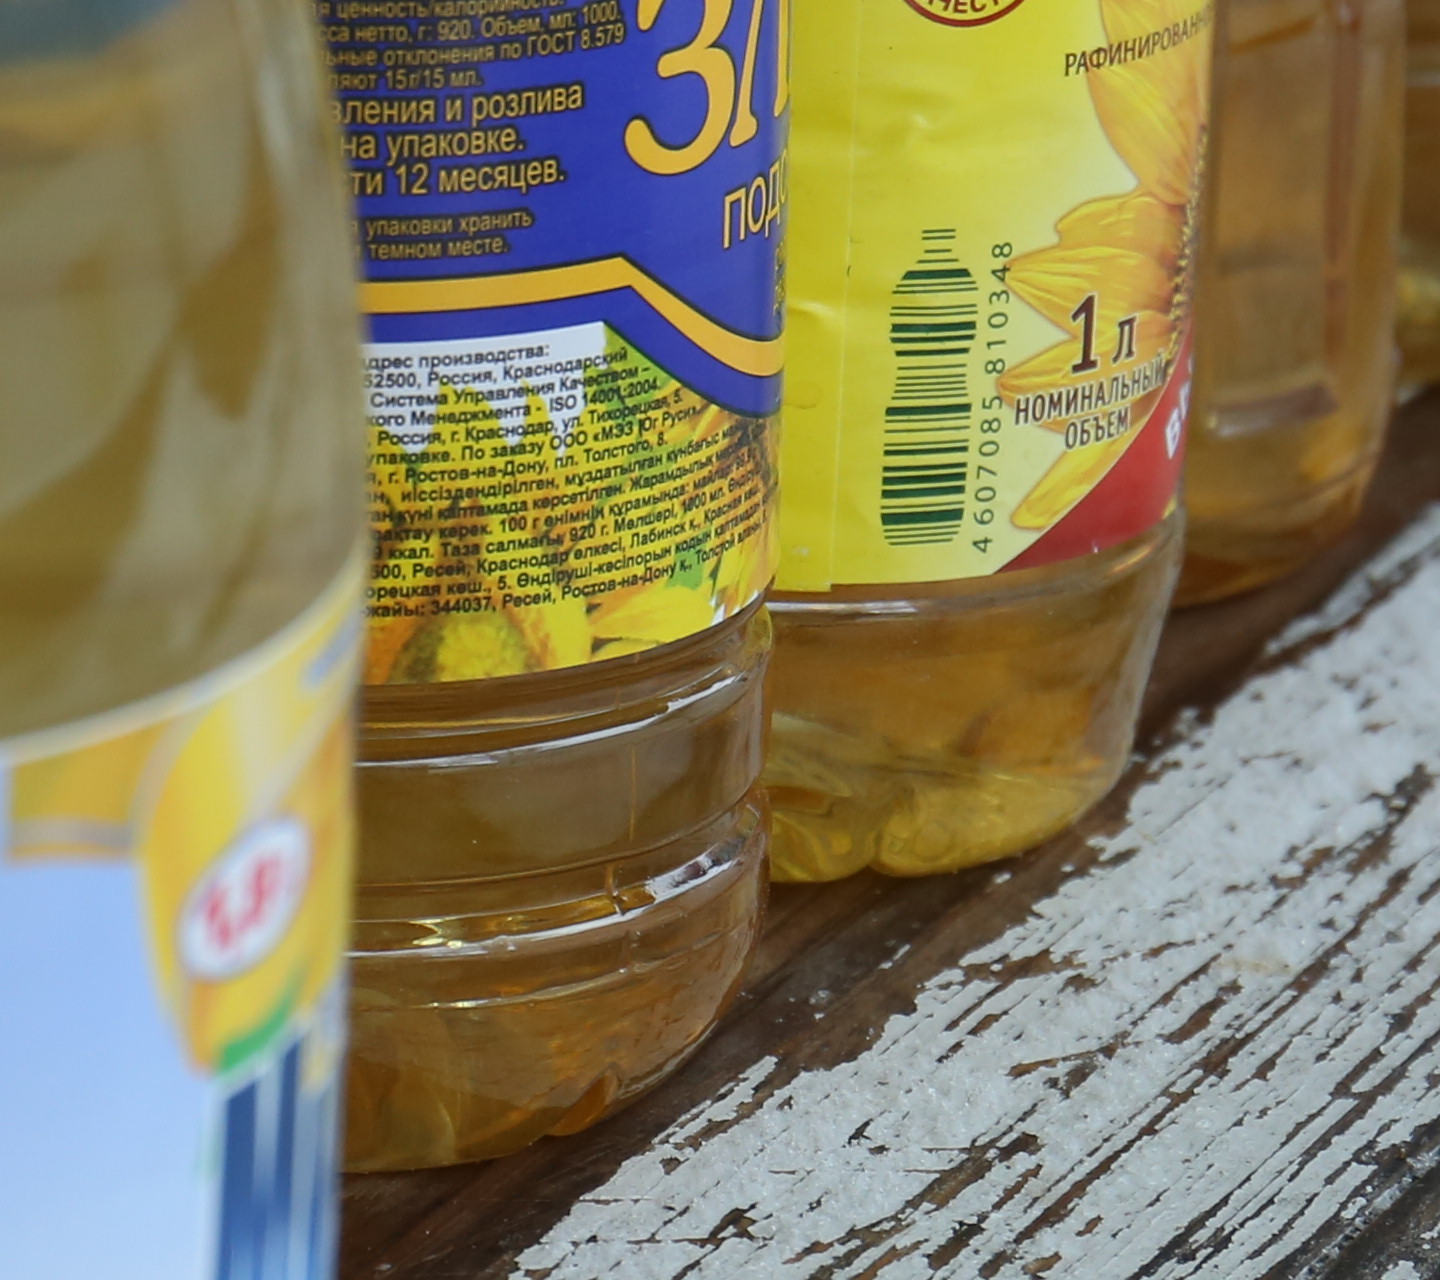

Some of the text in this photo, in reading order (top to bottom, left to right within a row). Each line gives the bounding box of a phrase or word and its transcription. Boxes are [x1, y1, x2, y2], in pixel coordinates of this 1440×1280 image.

[383, 45, 495, 66] отклонения
[500, 42, 522, 59] по
[527, 31, 576, 56] ГОСТ
[580, 23, 625, 50] 8.579
[444, 98, 462, 122] и
[472, 83, 583, 128] розлива
[386, 127, 524, 167] упаковке.
[395, 162, 429, 195] 12
[438, 158, 566, 195] месяцев.
[366, 216, 453, 241] упаковки
[459, 210, 534, 237] хранить
[368, 236, 510, 261] темном месте.
[1070, 293, 1139, 375] 1 л
[418, 344, 550, 372] производства:
[427, 370, 498, 387] Россия,
[503, 347, 629, 380] Краснодарский
[371, 365, 640, 408] Система Управления Качеством
[1014, 348, 1167, 428] НОМИНАЛЬНЫЙ
[377, 430, 447, 446] Россия,
[465, 419, 558, 444] Краснодар,
[1065, 402, 1132, 451] ОБЪЕМ
[405, 458, 550, 484] Ростов-на-Дону,
[554, 454, 579, 470] пл.
[584, 438, 654, 464] Толстого,
[461, 446, 485, 461] По
[440, 541, 481, 557] Таза
[476, 548, 570, 575] Краснодар
